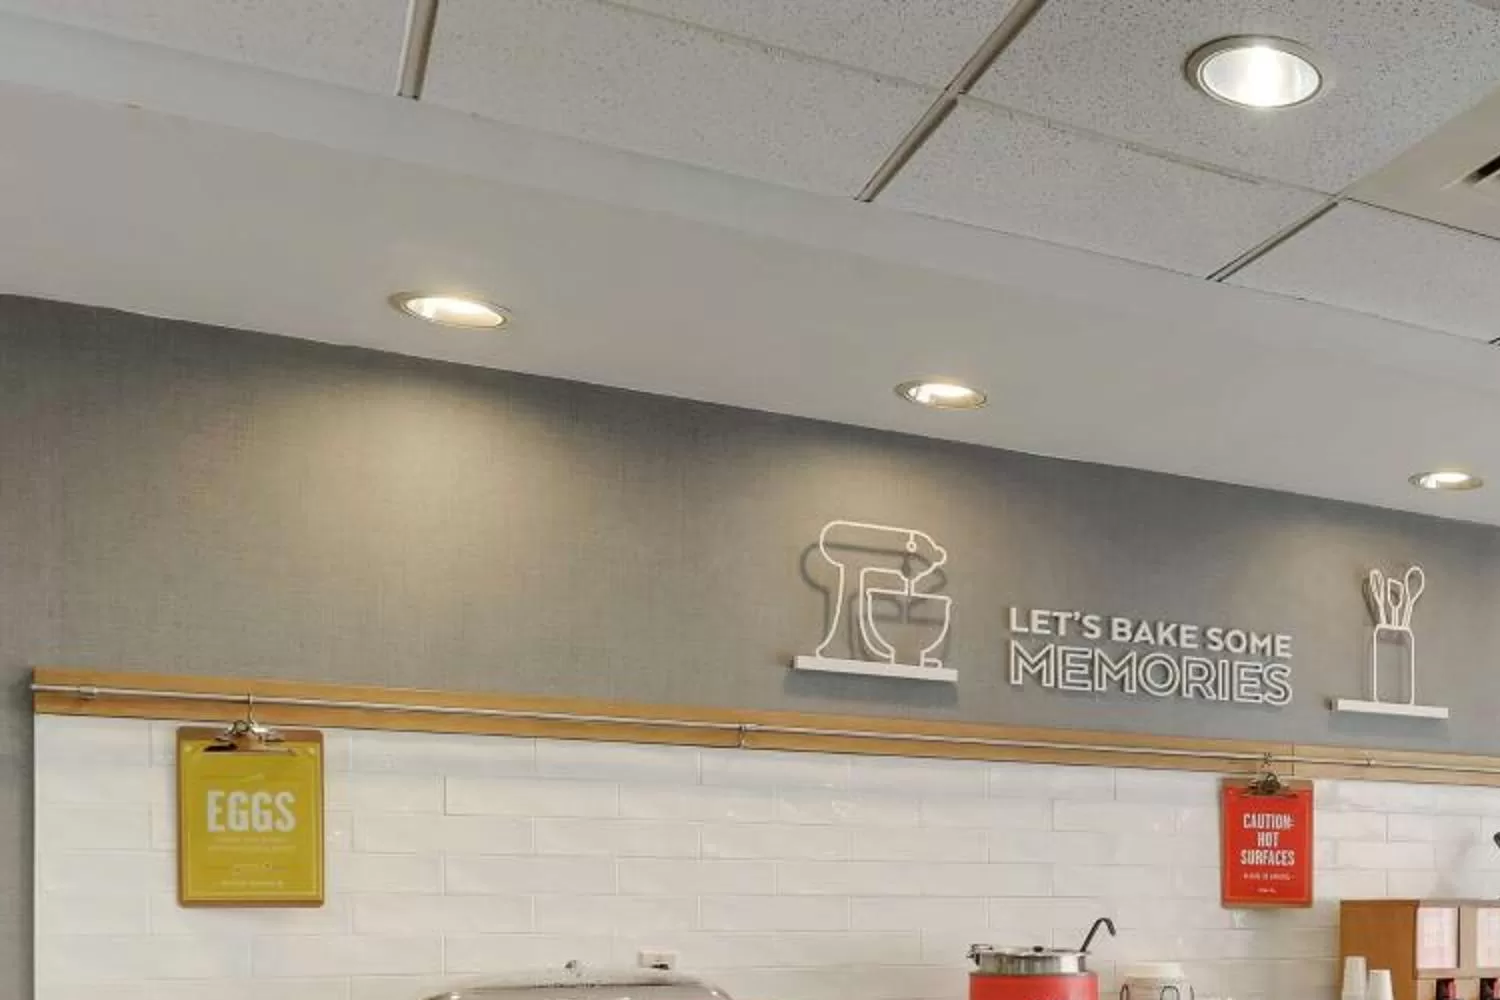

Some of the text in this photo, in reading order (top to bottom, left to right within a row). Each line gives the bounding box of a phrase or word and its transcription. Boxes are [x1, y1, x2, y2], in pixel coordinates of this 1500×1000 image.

[1009, 606, 1293, 659] LET'S BAKE SOME
[1009, 639, 1293, 706] MEMORIES
[206, 789, 297, 833] EGGS
[1240, 849, 1295, 866] SURFACES
[1257, 831, 1280, 847] HOT
